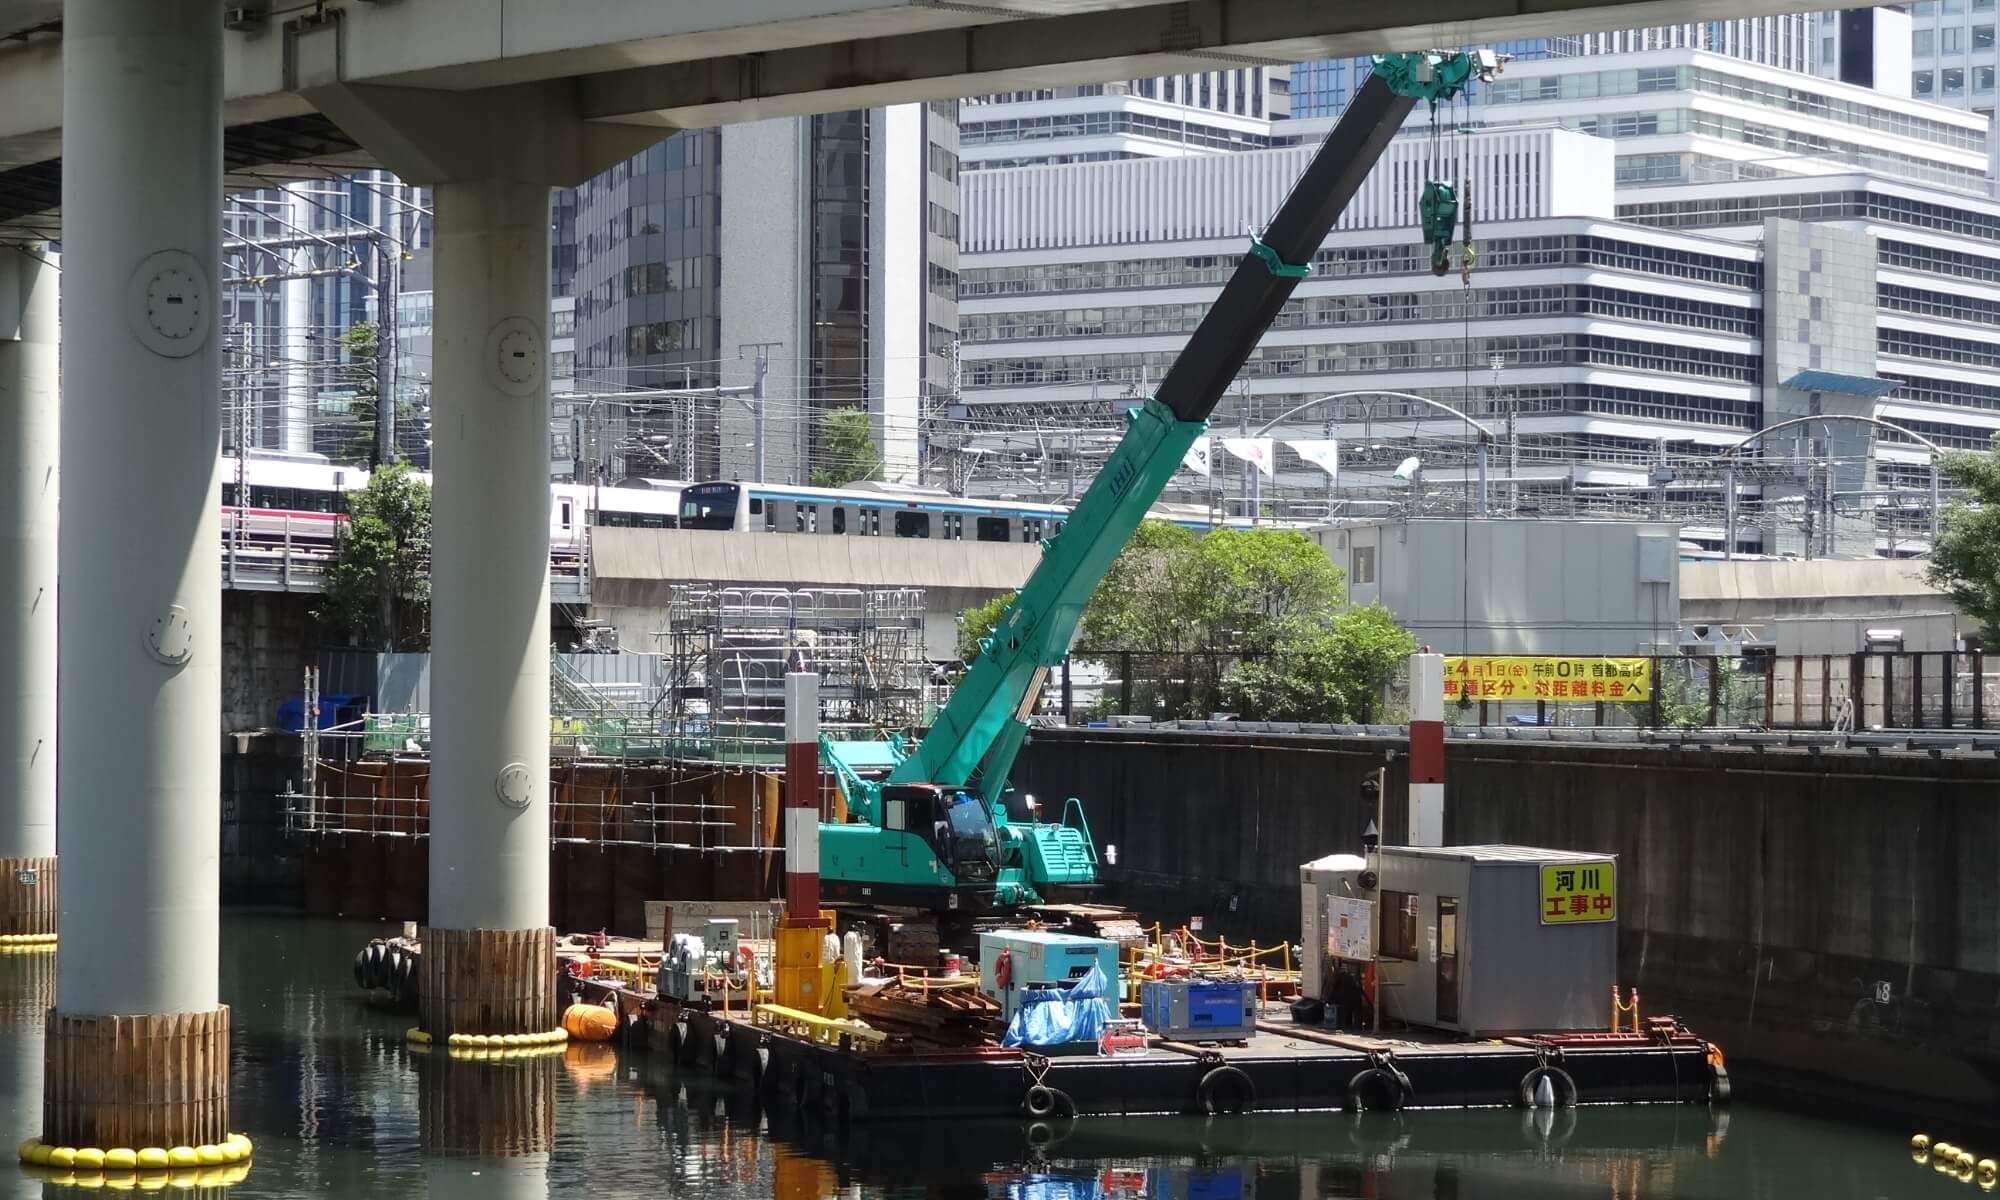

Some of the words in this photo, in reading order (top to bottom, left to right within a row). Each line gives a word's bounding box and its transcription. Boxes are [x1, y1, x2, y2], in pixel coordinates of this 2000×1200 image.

[1555, 868, 1599, 892] 河川
[1546, 893, 1612, 916] 工事中
